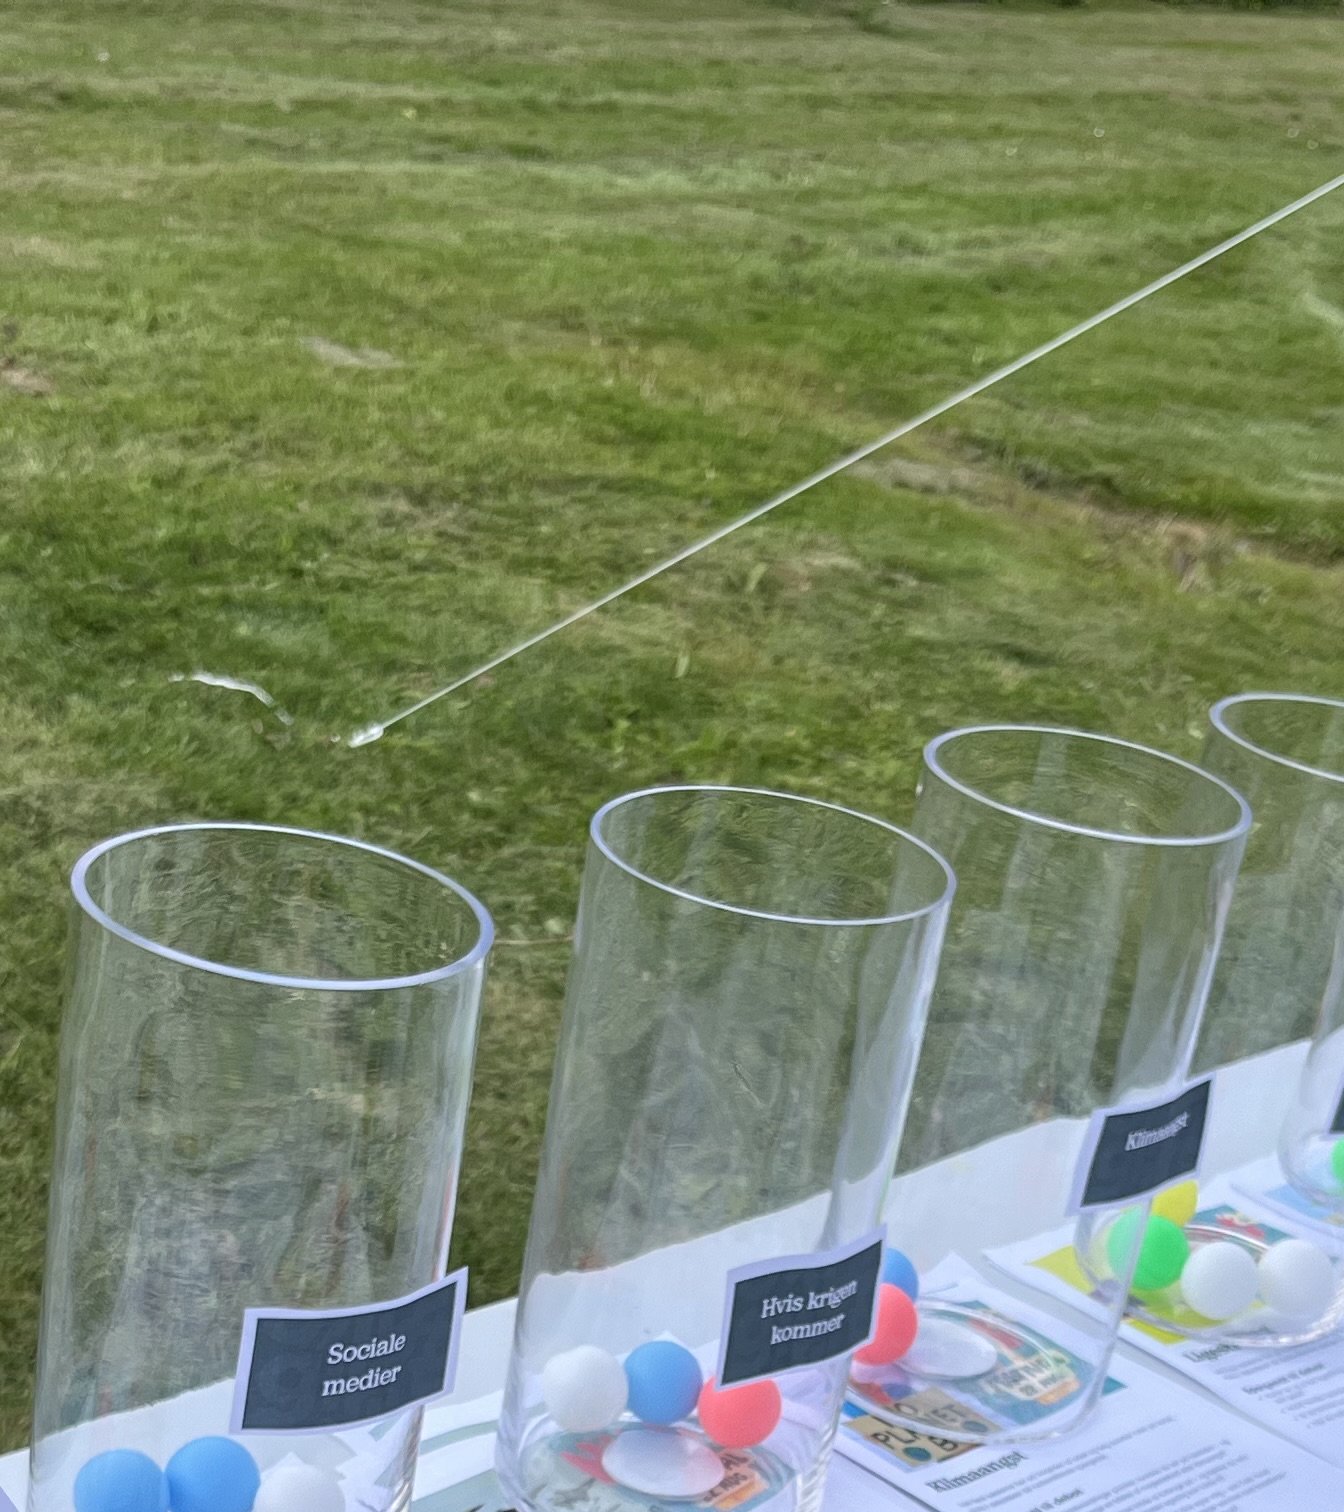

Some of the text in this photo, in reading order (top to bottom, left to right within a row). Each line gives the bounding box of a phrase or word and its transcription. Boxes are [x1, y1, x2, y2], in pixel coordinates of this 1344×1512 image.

[761, 1280, 857, 1318] Hvis krigen
[770, 1313, 846, 1345] kommer
[327, 1333, 406, 1366] Sociale
[321, 1363, 402, 1397] medier
